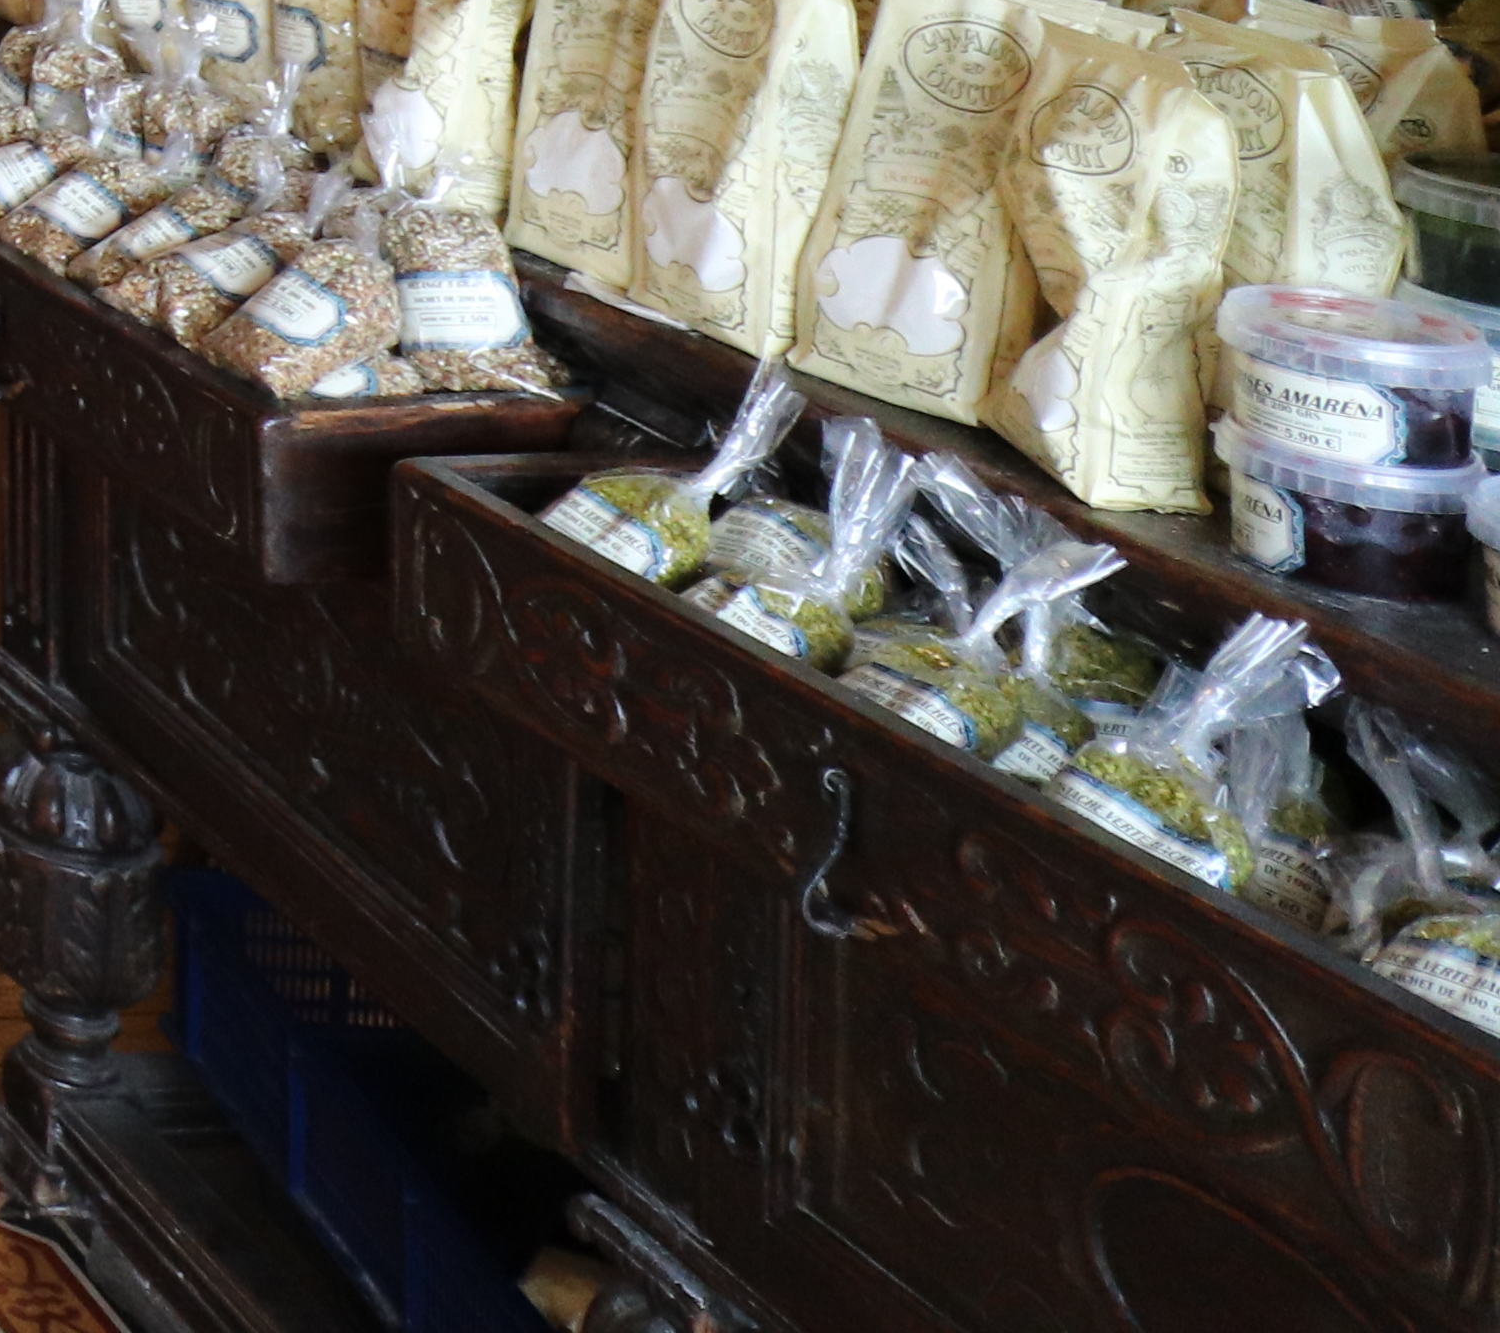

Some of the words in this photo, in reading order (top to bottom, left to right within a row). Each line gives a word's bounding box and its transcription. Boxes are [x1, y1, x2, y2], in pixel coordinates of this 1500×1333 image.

[1279, 386, 1384, 420] AMARÉNA
[1283, 427, 1319, 446] 5.90
[1325, 436, 1337, 449] €
[1243, 492, 1284, 522] RÉNA
[1058, 782, 1107, 820] STACHE
[1104, 809, 1148, 845] VERTE
[1263, 864, 1281, 877] DE
[1422, 956, 1472, 988] VERTE
[1438, 987, 1457, 1001] DE
[1461, 992, 1489, 1011] 100
